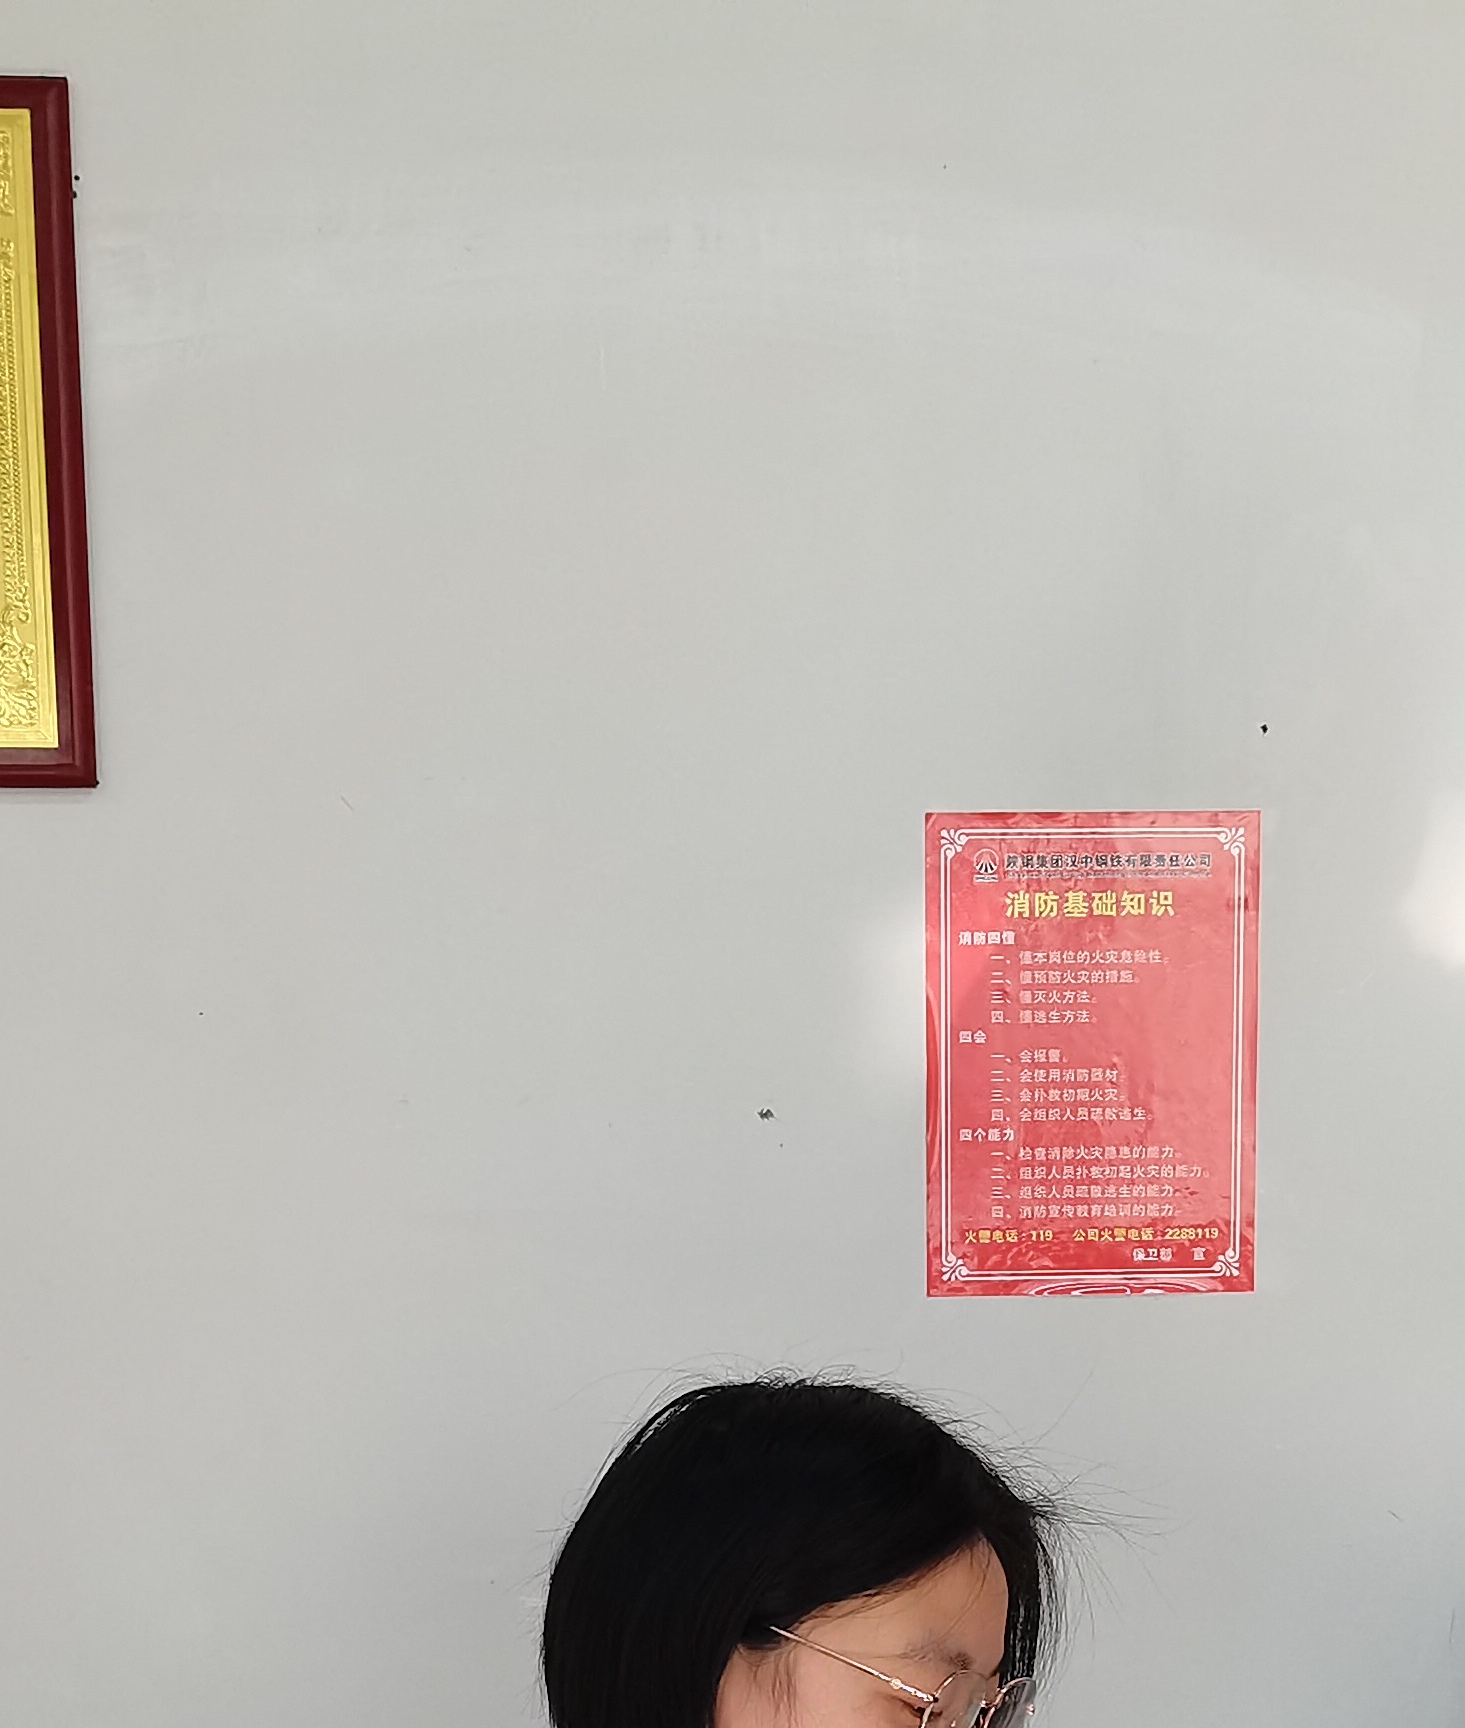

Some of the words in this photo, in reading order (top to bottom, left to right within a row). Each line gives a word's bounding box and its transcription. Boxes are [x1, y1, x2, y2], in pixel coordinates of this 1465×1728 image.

[1005, 889, 1176, 919] 消防基础知识
[958, 1029, 987, 1044] 四会
[958, 1127, 1015, 1142] 四个能力
